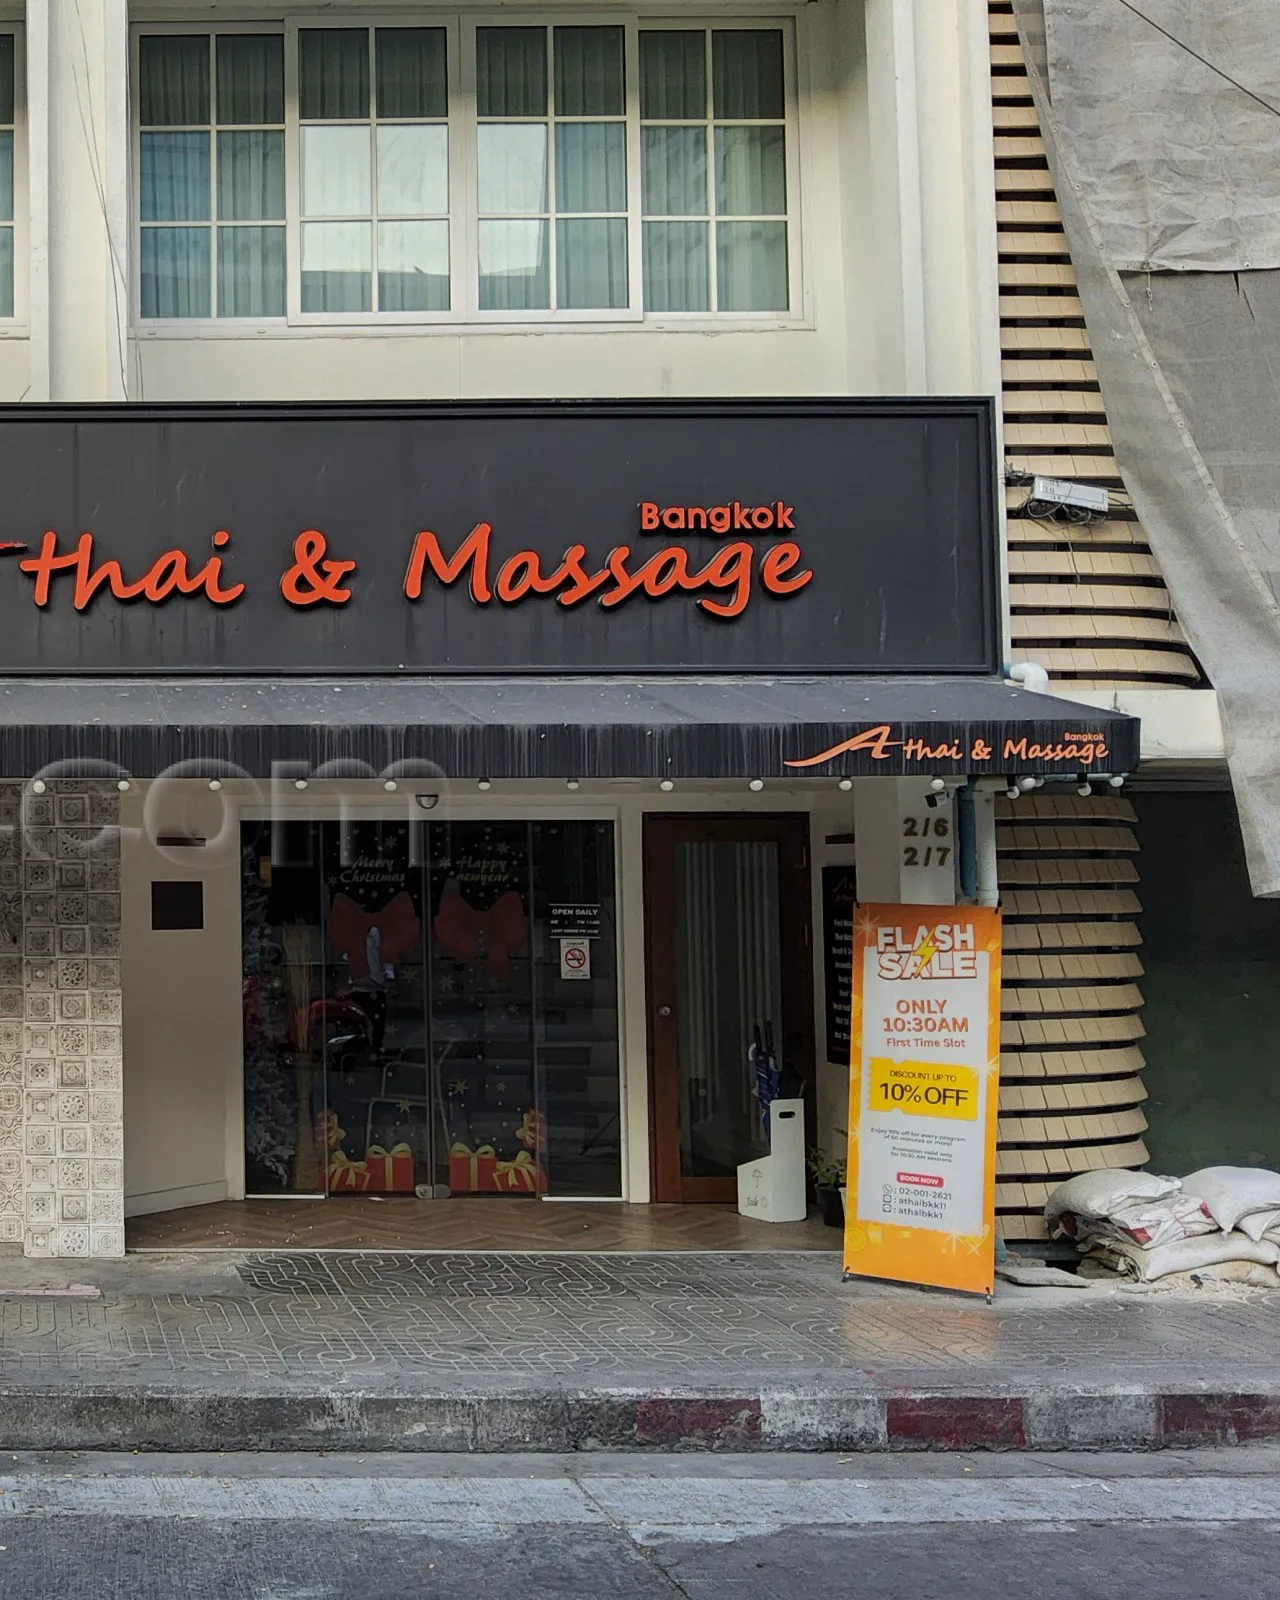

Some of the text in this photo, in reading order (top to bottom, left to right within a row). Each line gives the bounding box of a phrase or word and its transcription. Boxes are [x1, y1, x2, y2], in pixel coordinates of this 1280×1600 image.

[640, 500, 796, 534] Bangkok
[20, 529, 247, 612] thai
[280, 529, 358, 608] &
[404, 522, 816, 620] Massage
[1063, 731, 1105, 743] Bangkok
[903, 738, 963, 761] thai
[971, 738, 992, 760] &
[1003, 737, 1110, 764] Massage
[902, 816, 949, 838] 2/6
[455, 854, 508, 873] Happy
[903, 846, 952, 868] 2/7
[339, 868, 406, 883] Christmas
[551, 908, 574, 916] OPEN
[876, 922, 976, 953] FLASH
[877, 950, 978, 980] SALE
[895, 998, 948, 1015] ONLY
[882, 1016, 969, 1033] 10:30AM
[885, 1037, 967, 1049] First Time Slot
[889, 1069, 957, 1083] DISCOUNT UP TO
[879, 1082, 970, 1107] 10% OFF
[870, 1127, 888, 1135] Enjoy
[939, 1135, 967, 1143] program
[900, 1136, 925, 1144] minutes
[939, 1151, 953, 1159] only
[899, 1174, 940, 1185] BOOK NOW
[898, 1186, 953, 1201] 02-001-2621
